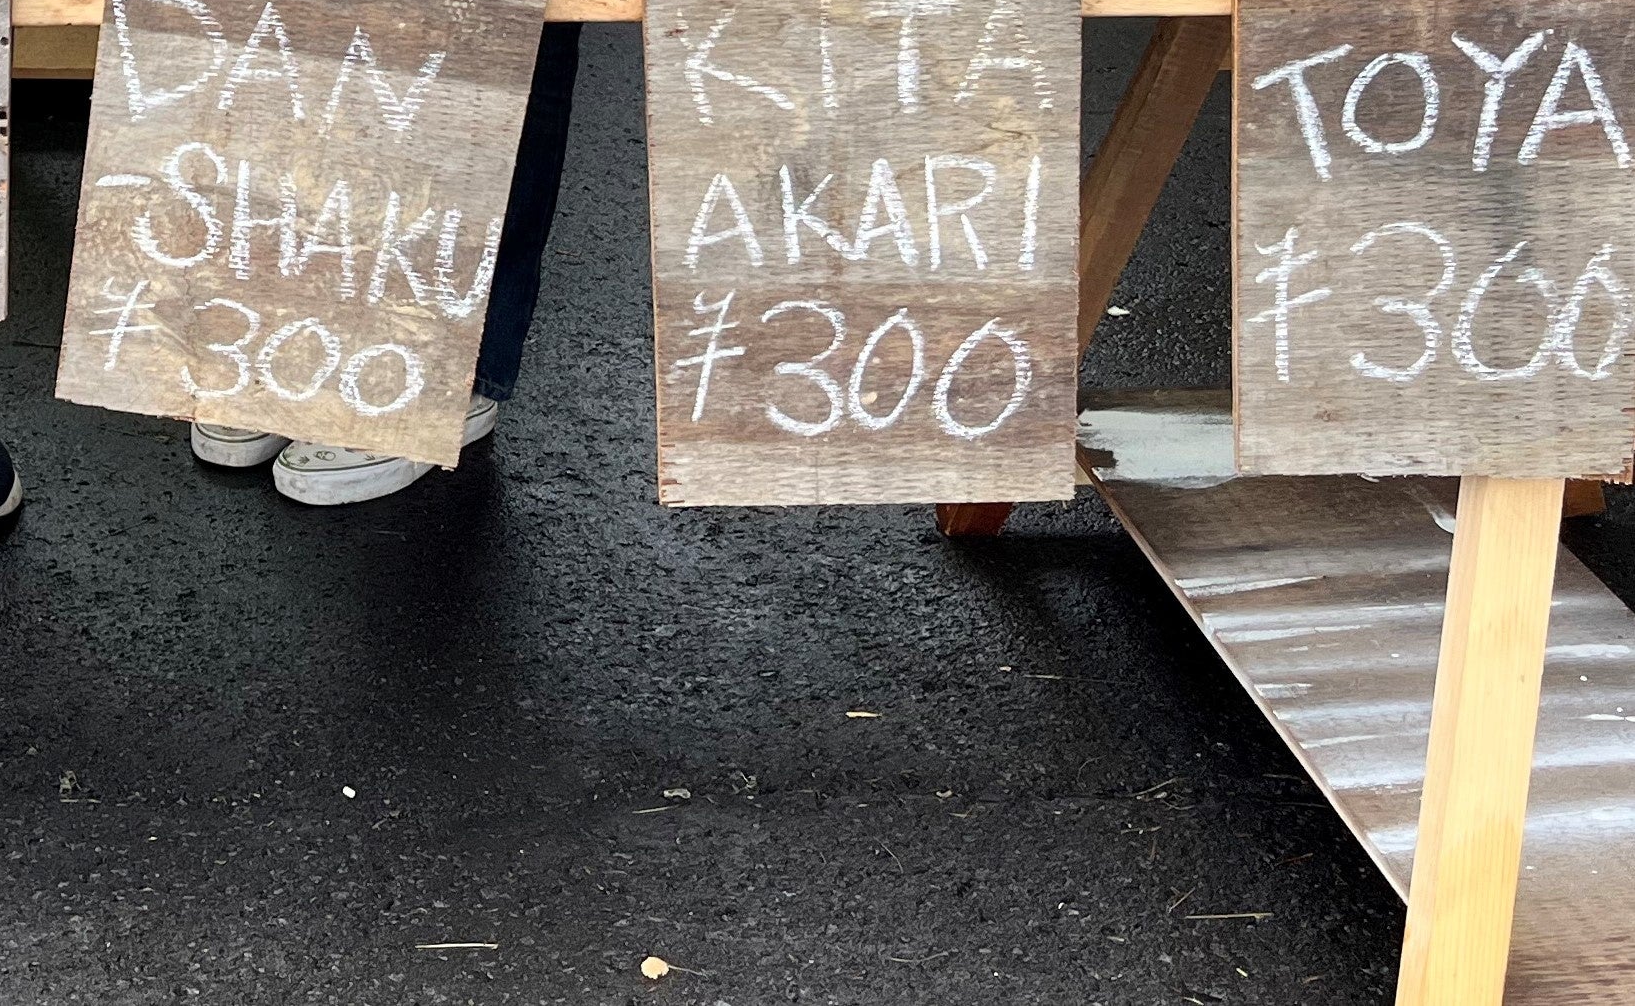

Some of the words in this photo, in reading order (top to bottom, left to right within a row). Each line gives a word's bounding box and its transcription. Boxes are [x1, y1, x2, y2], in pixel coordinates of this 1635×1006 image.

[1250, 29, 1633, 184] TOYA
[683, 154, 1042, 272] AKARI
[88, 275, 427, 416] ¥300
[668, 289, 1034, 441] ¥300
[1246, 222, 1634, 384] ¥300
